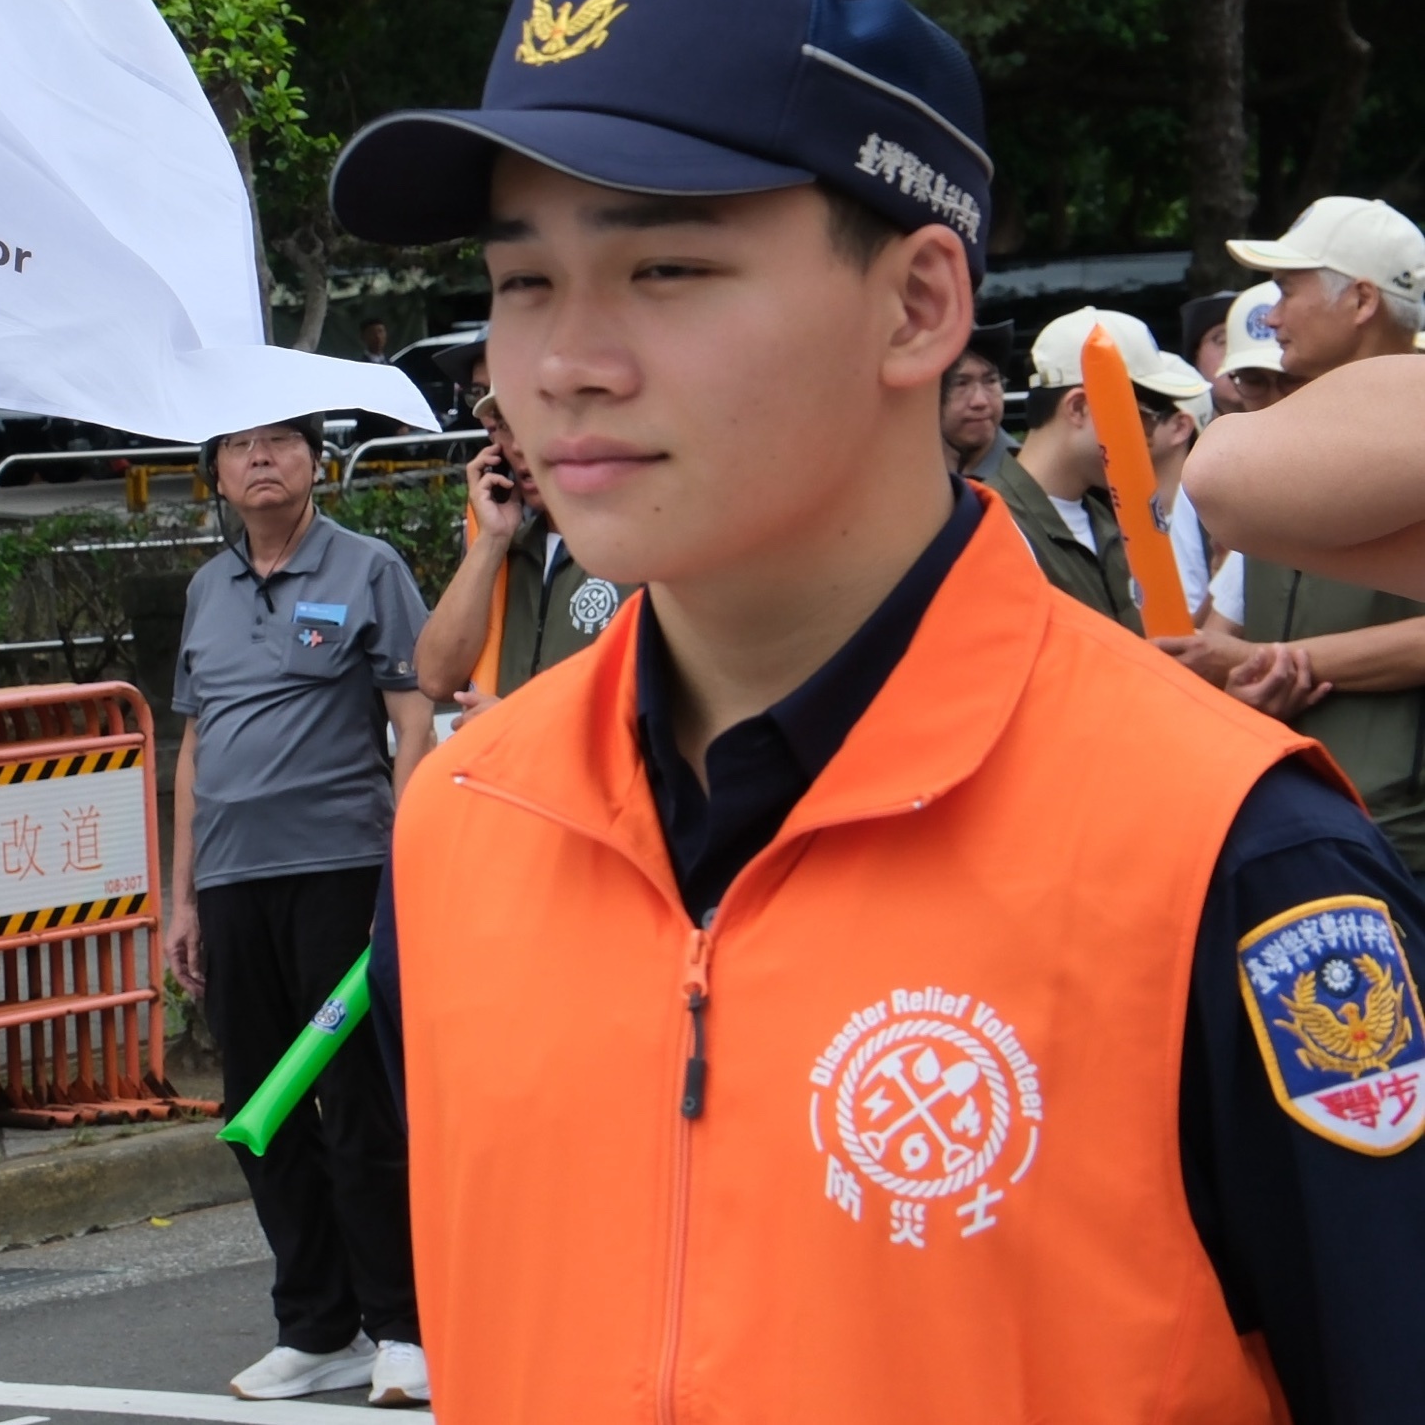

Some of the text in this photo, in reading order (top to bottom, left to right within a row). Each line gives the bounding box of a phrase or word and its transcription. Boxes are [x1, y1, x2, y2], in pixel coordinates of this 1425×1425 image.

[809, 986, 1043, 1121] Disaster Relief Volunteer
[825, 1153, 1004, 1249] 防災士
